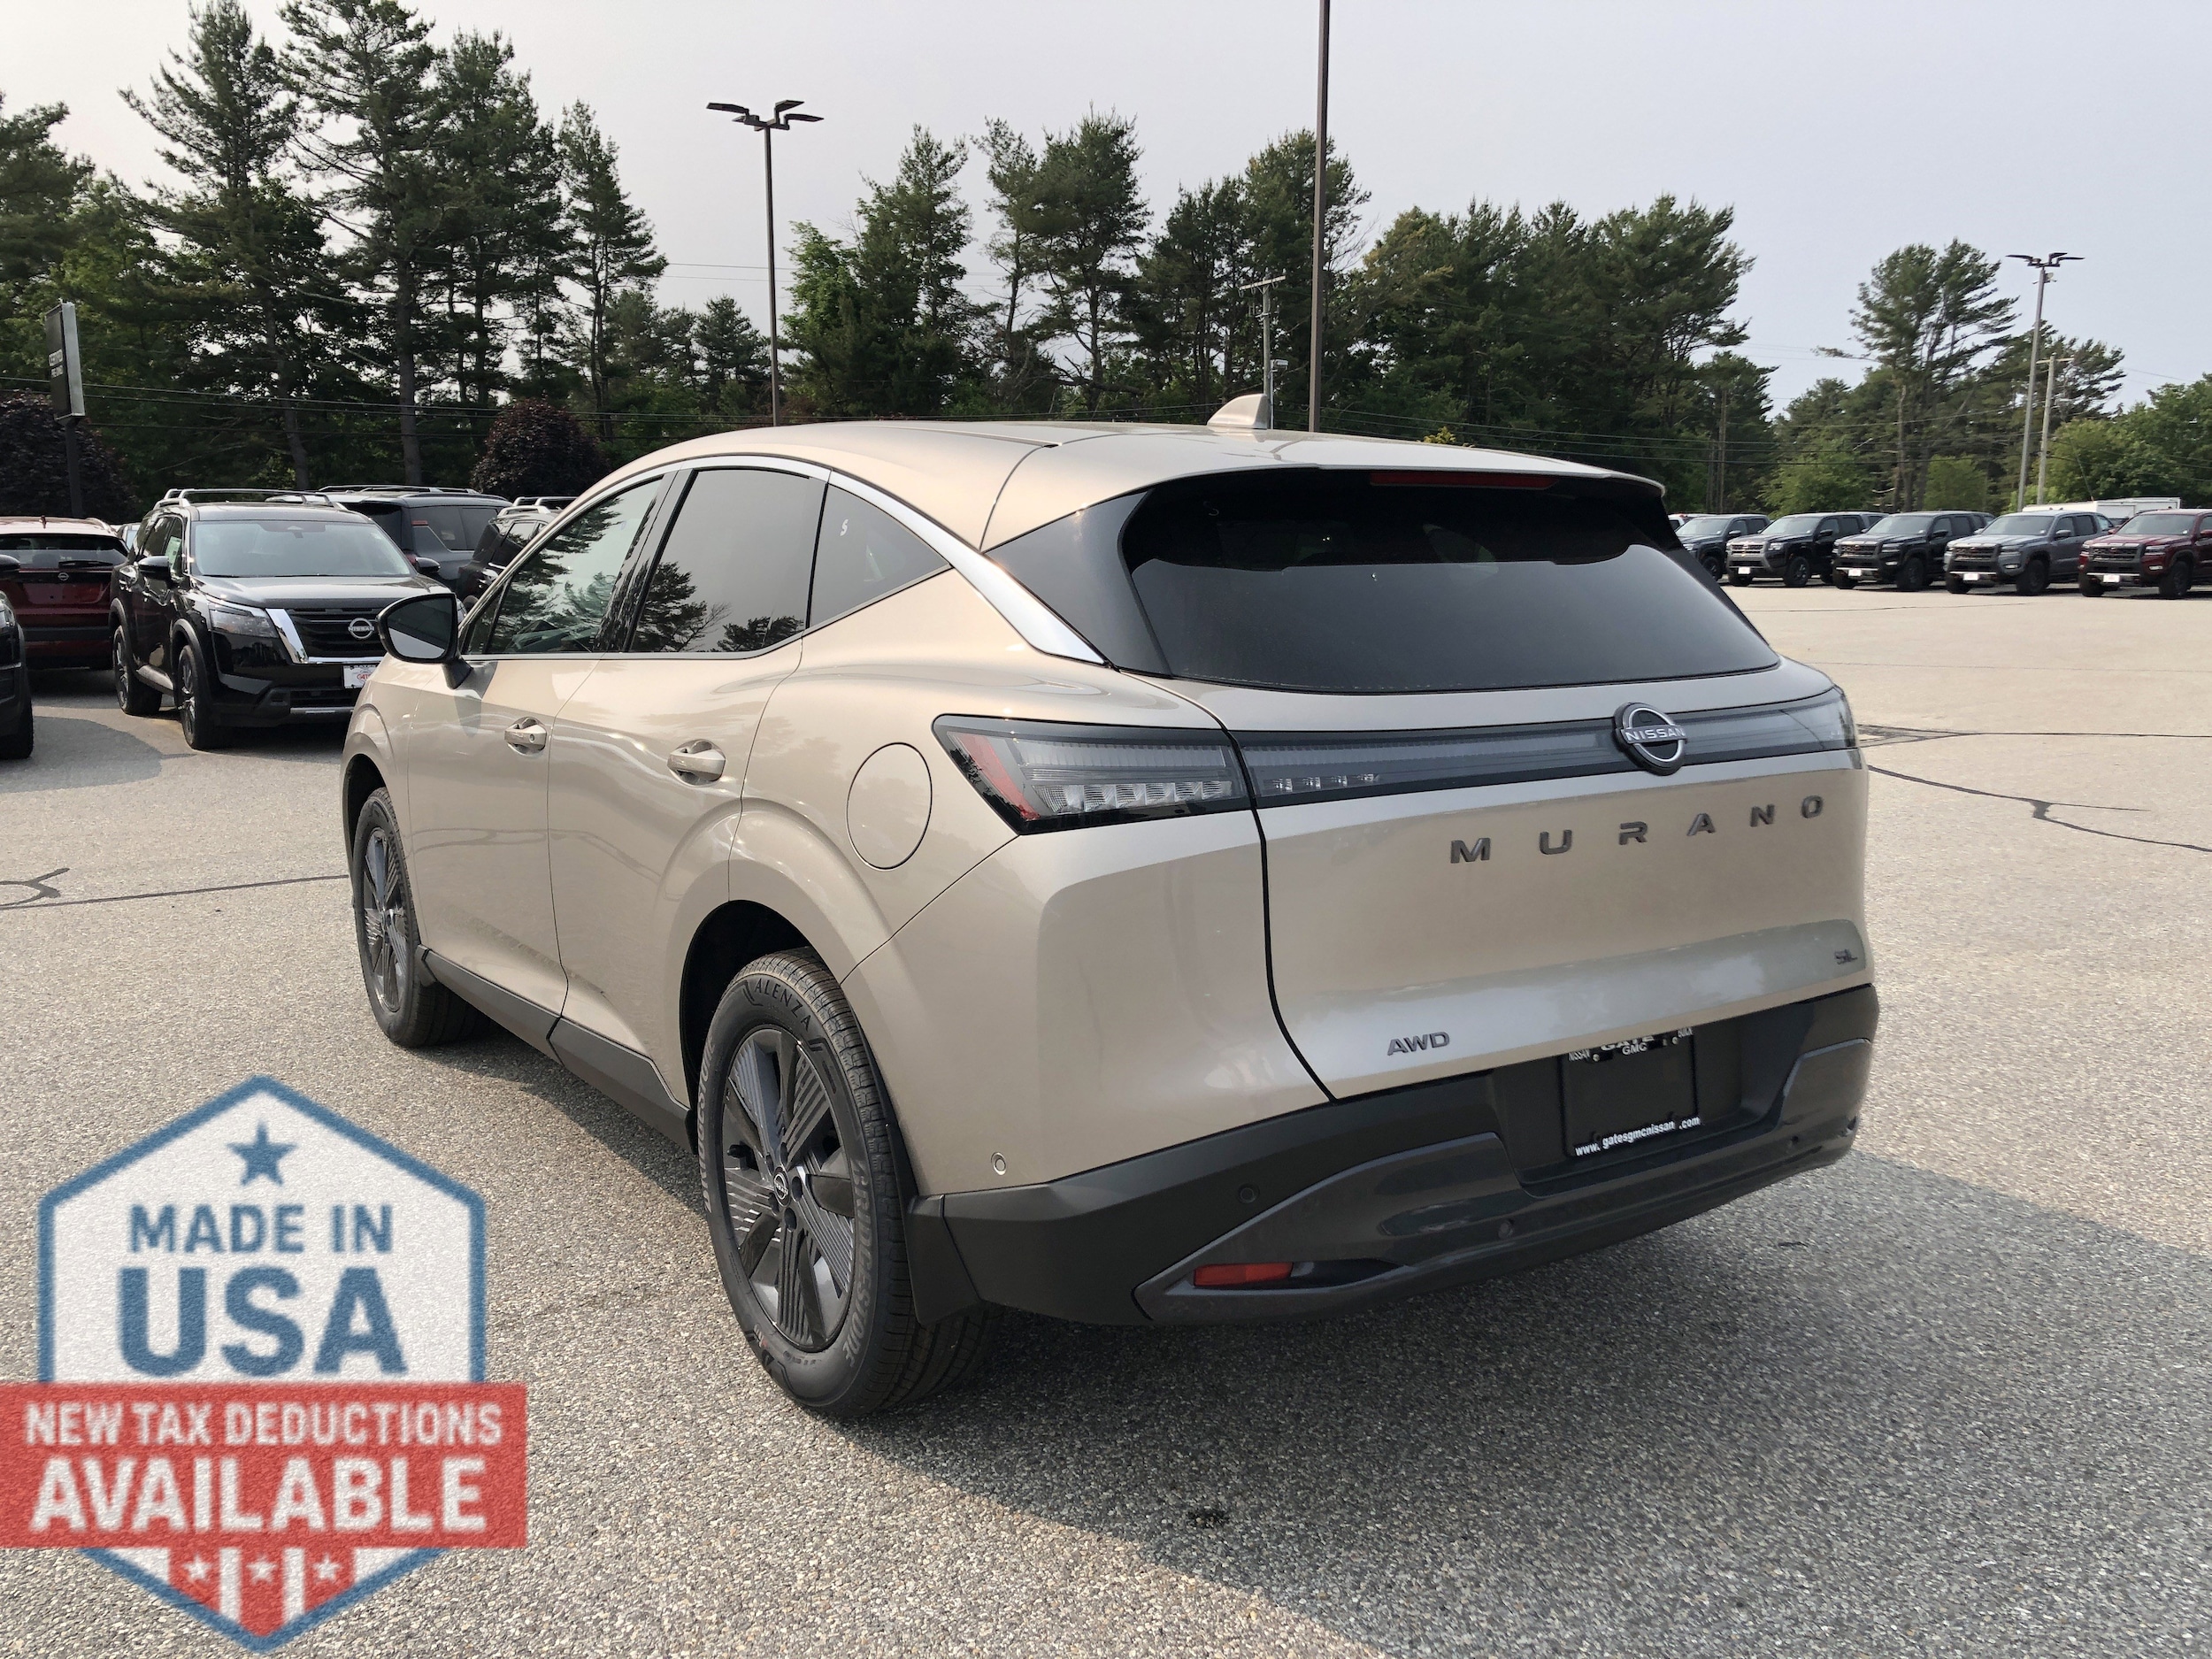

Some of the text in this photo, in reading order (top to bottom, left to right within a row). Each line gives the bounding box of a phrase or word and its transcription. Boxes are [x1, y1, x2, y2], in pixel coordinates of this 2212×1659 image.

[1624, 727, 1686, 741] NISSAN
[1450, 795, 1824, 864] MURANO
[755, 978, 811, 1033] ALENZA
[1386, 1031, 1450, 1056] AWD
[1622, 1042, 1647, 1056] GMC
[1575, 1116, 1701, 1156] www. gatesgmcnissan .com
